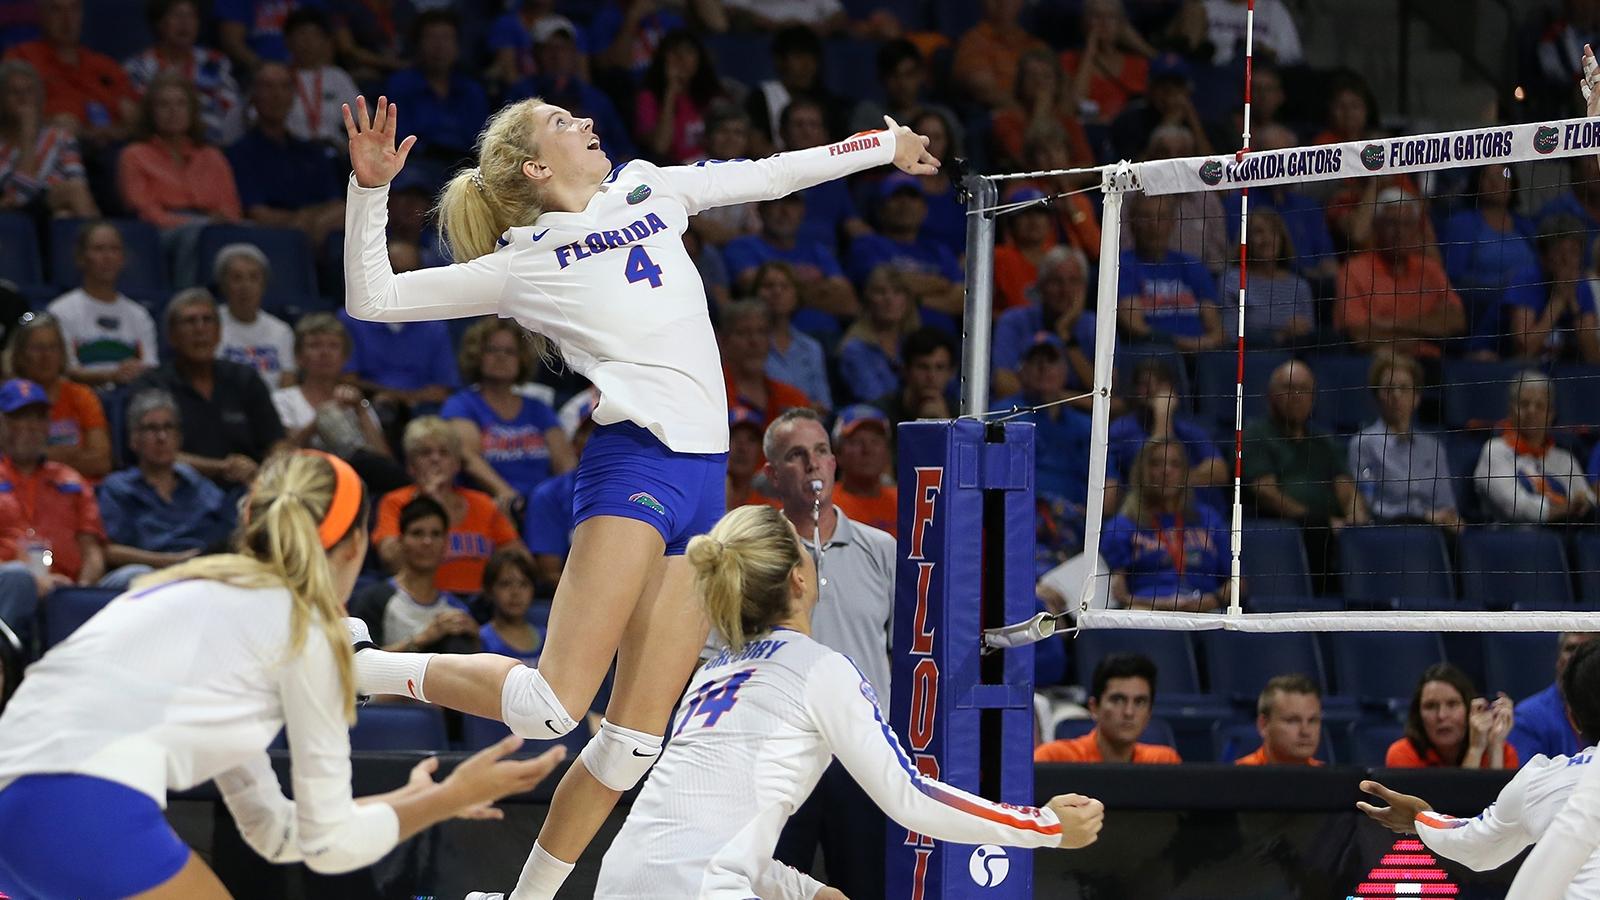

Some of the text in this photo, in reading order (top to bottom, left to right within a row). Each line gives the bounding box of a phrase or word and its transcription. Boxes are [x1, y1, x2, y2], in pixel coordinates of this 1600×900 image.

[829, 137, 881, 156] FLORIDA
[1226, 147, 1342, 183] FLORIDA GATORS
[1390, 131, 1513, 167] FLORIDA GATORS
[554, 212, 668, 270] FLORIDA
[624, 244, 663, 288] 4
[673, 669, 757, 737] 14
